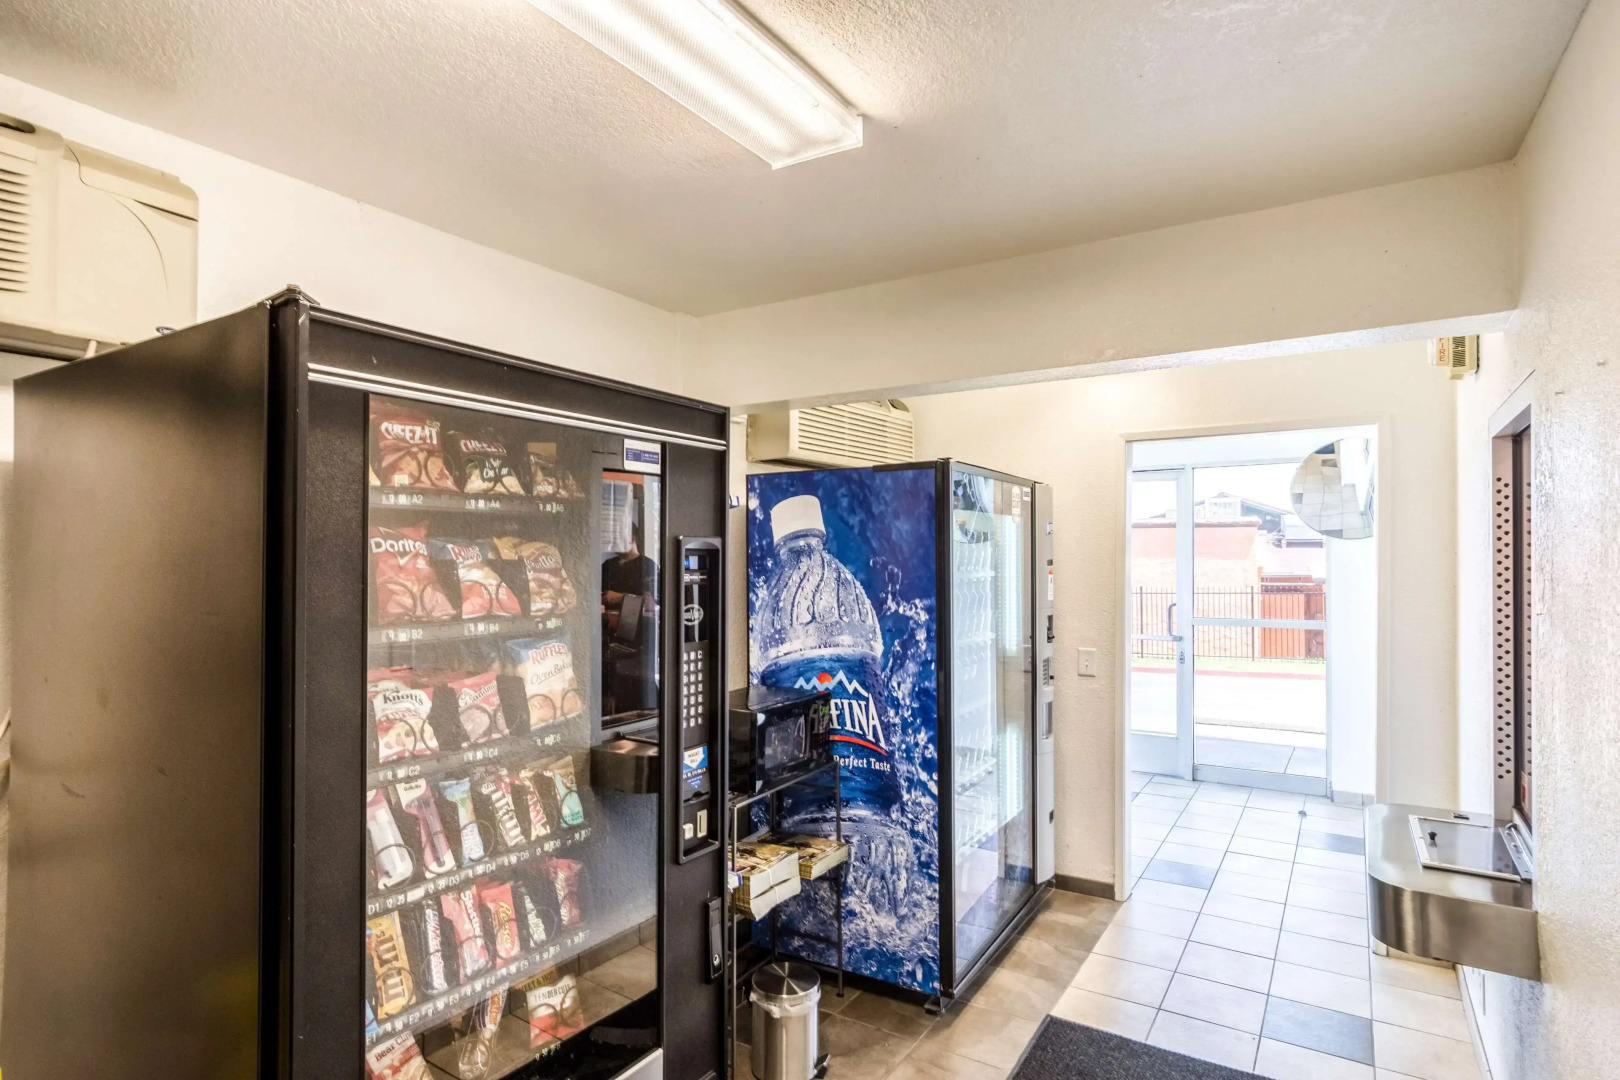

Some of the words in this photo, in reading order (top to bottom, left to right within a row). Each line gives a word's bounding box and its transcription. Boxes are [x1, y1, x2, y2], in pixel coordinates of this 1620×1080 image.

[411, 494, 424, 504] A2
[411, 629, 423, 639] B2
[829, 692, 888, 751] FINA
[869, 757, 891, 772] Taste
[409, 765, 420, 776] C2
[449, 876, 460, 887] D3
[368, 903, 380, 914] D1
[374, 1042, 395, 1062] Bear
